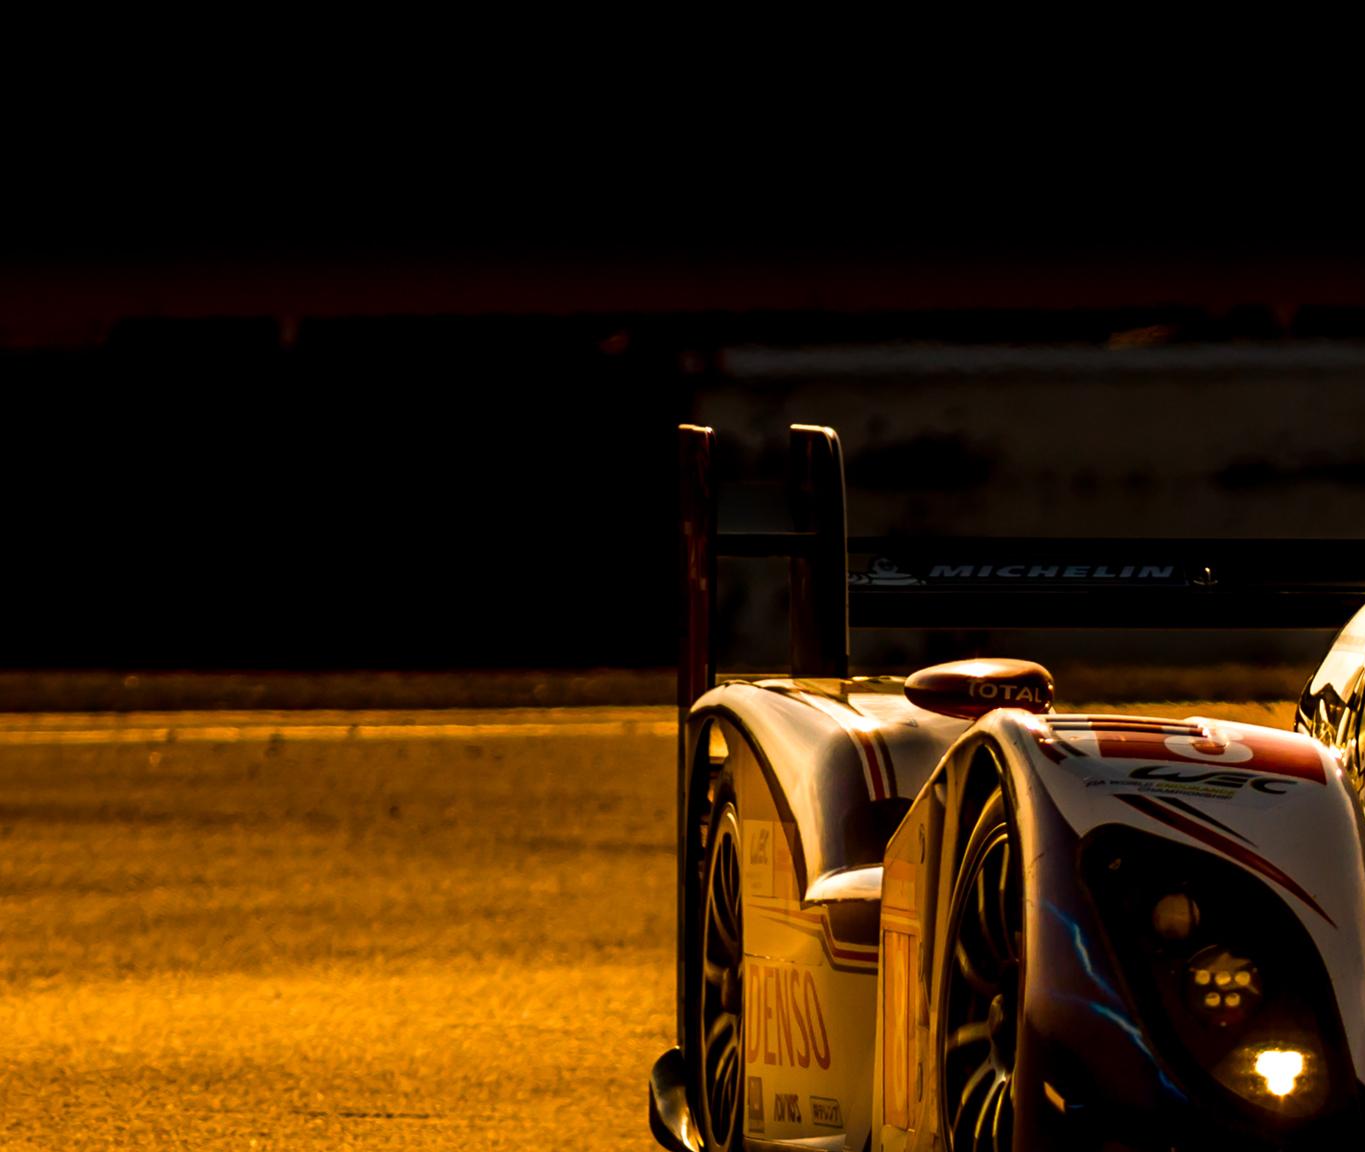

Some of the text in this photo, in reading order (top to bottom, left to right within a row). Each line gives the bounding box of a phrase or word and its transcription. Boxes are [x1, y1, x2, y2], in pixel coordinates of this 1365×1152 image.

[929, 564, 1174, 578] MICHELIN
[967, 679, 1043, 703] TOTAL
[1129, 766, 1297, 795] WEC
[743, 965, 832, 1070] DENSO
